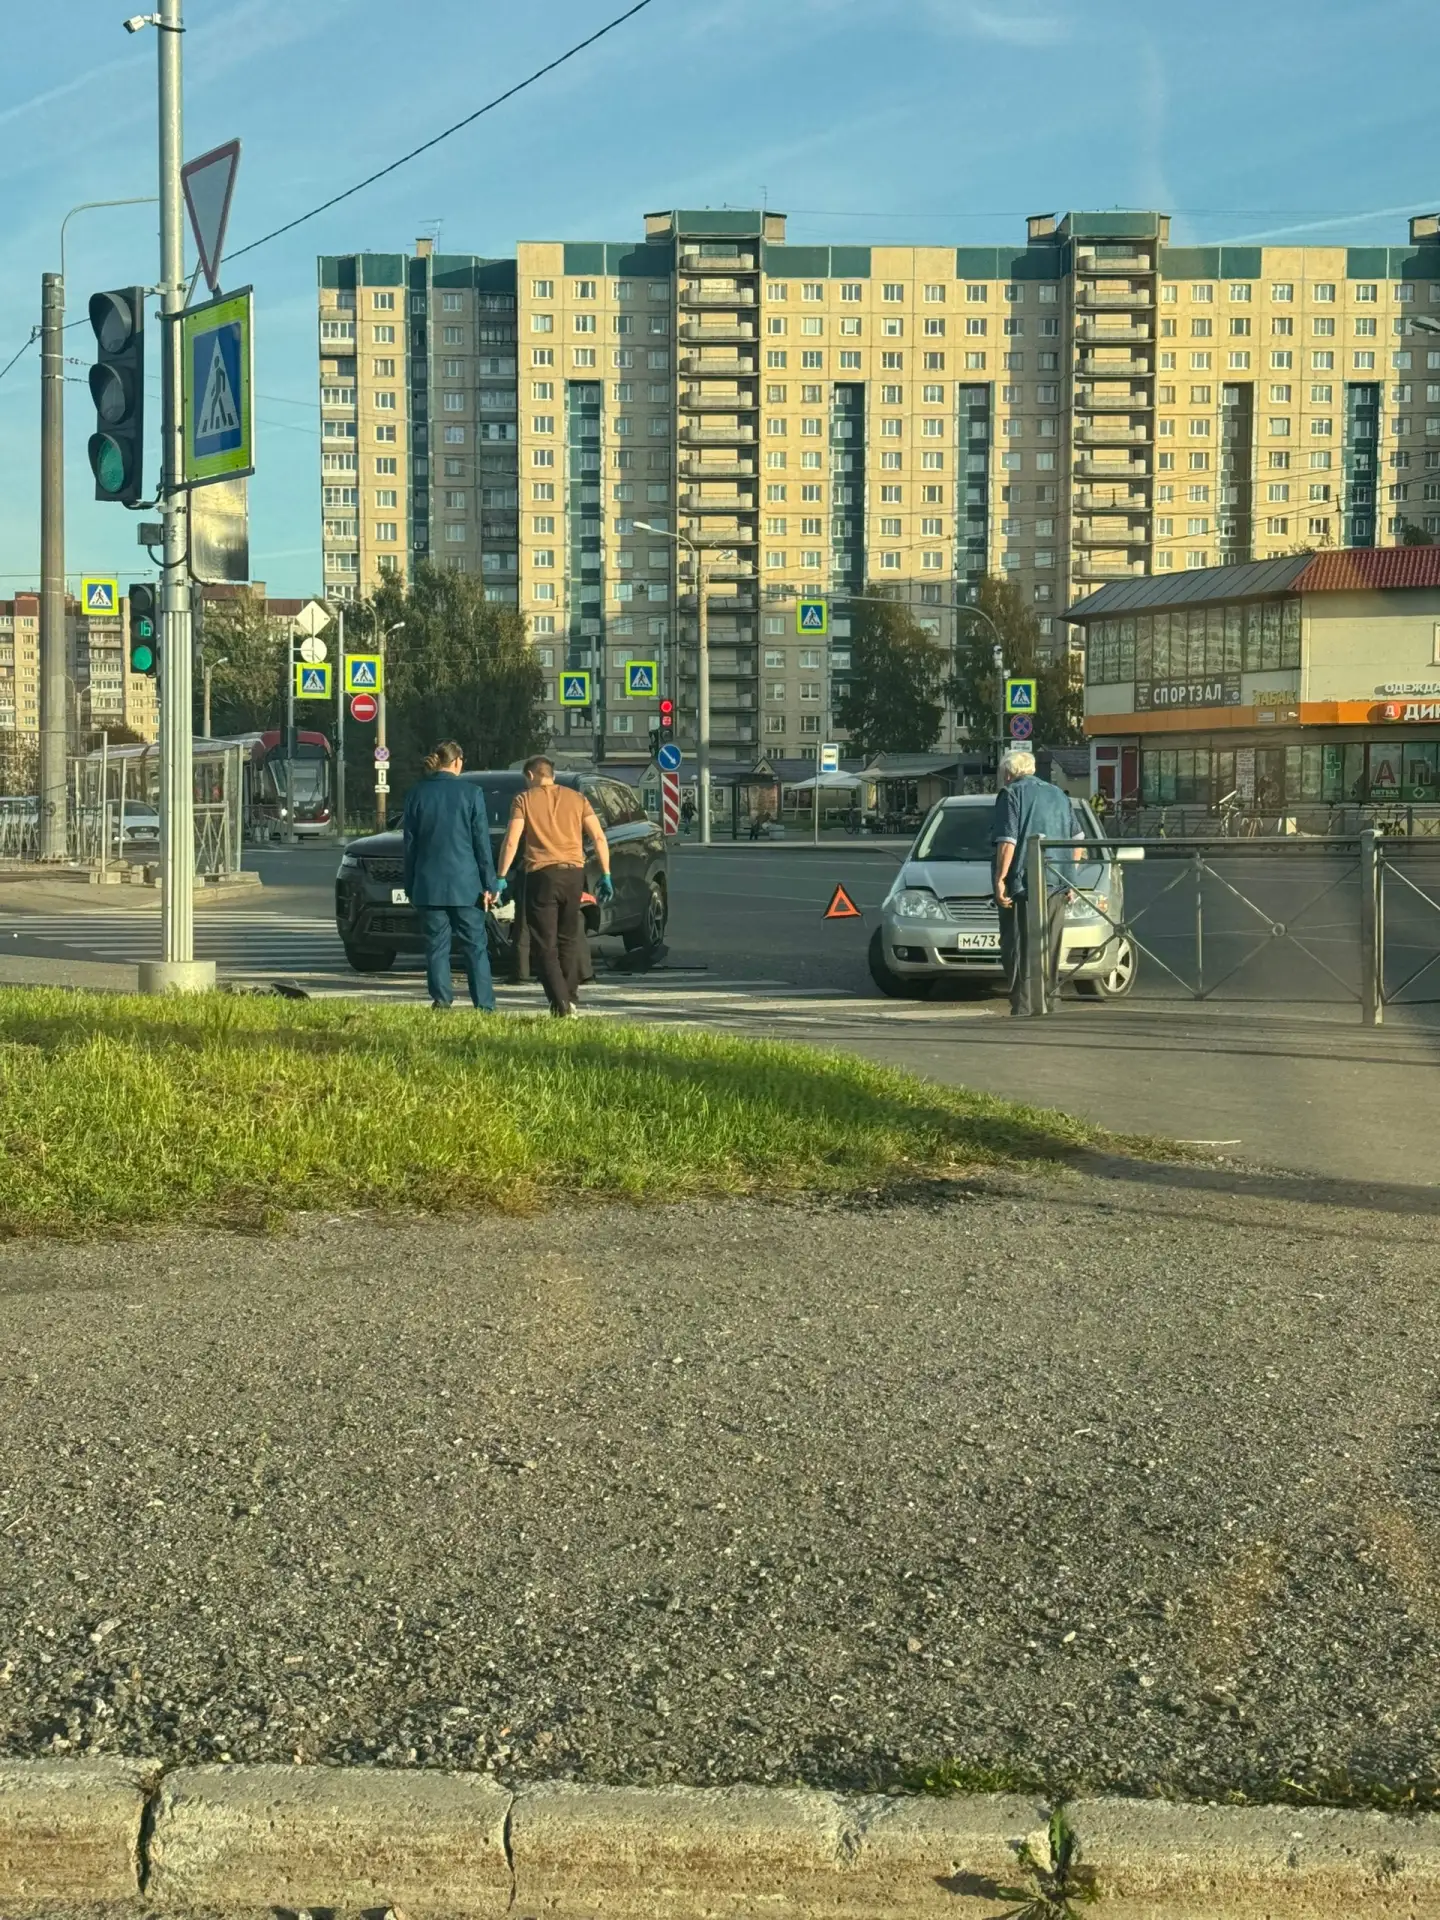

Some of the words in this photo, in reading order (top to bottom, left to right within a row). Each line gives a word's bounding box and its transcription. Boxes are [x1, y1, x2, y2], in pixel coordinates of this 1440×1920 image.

[1153, 683, 1222, 704] СПОРТЗАЛ
[1254, 690, 1296, 707] ТАБАК
[962, 934, 1001, 948] М473
